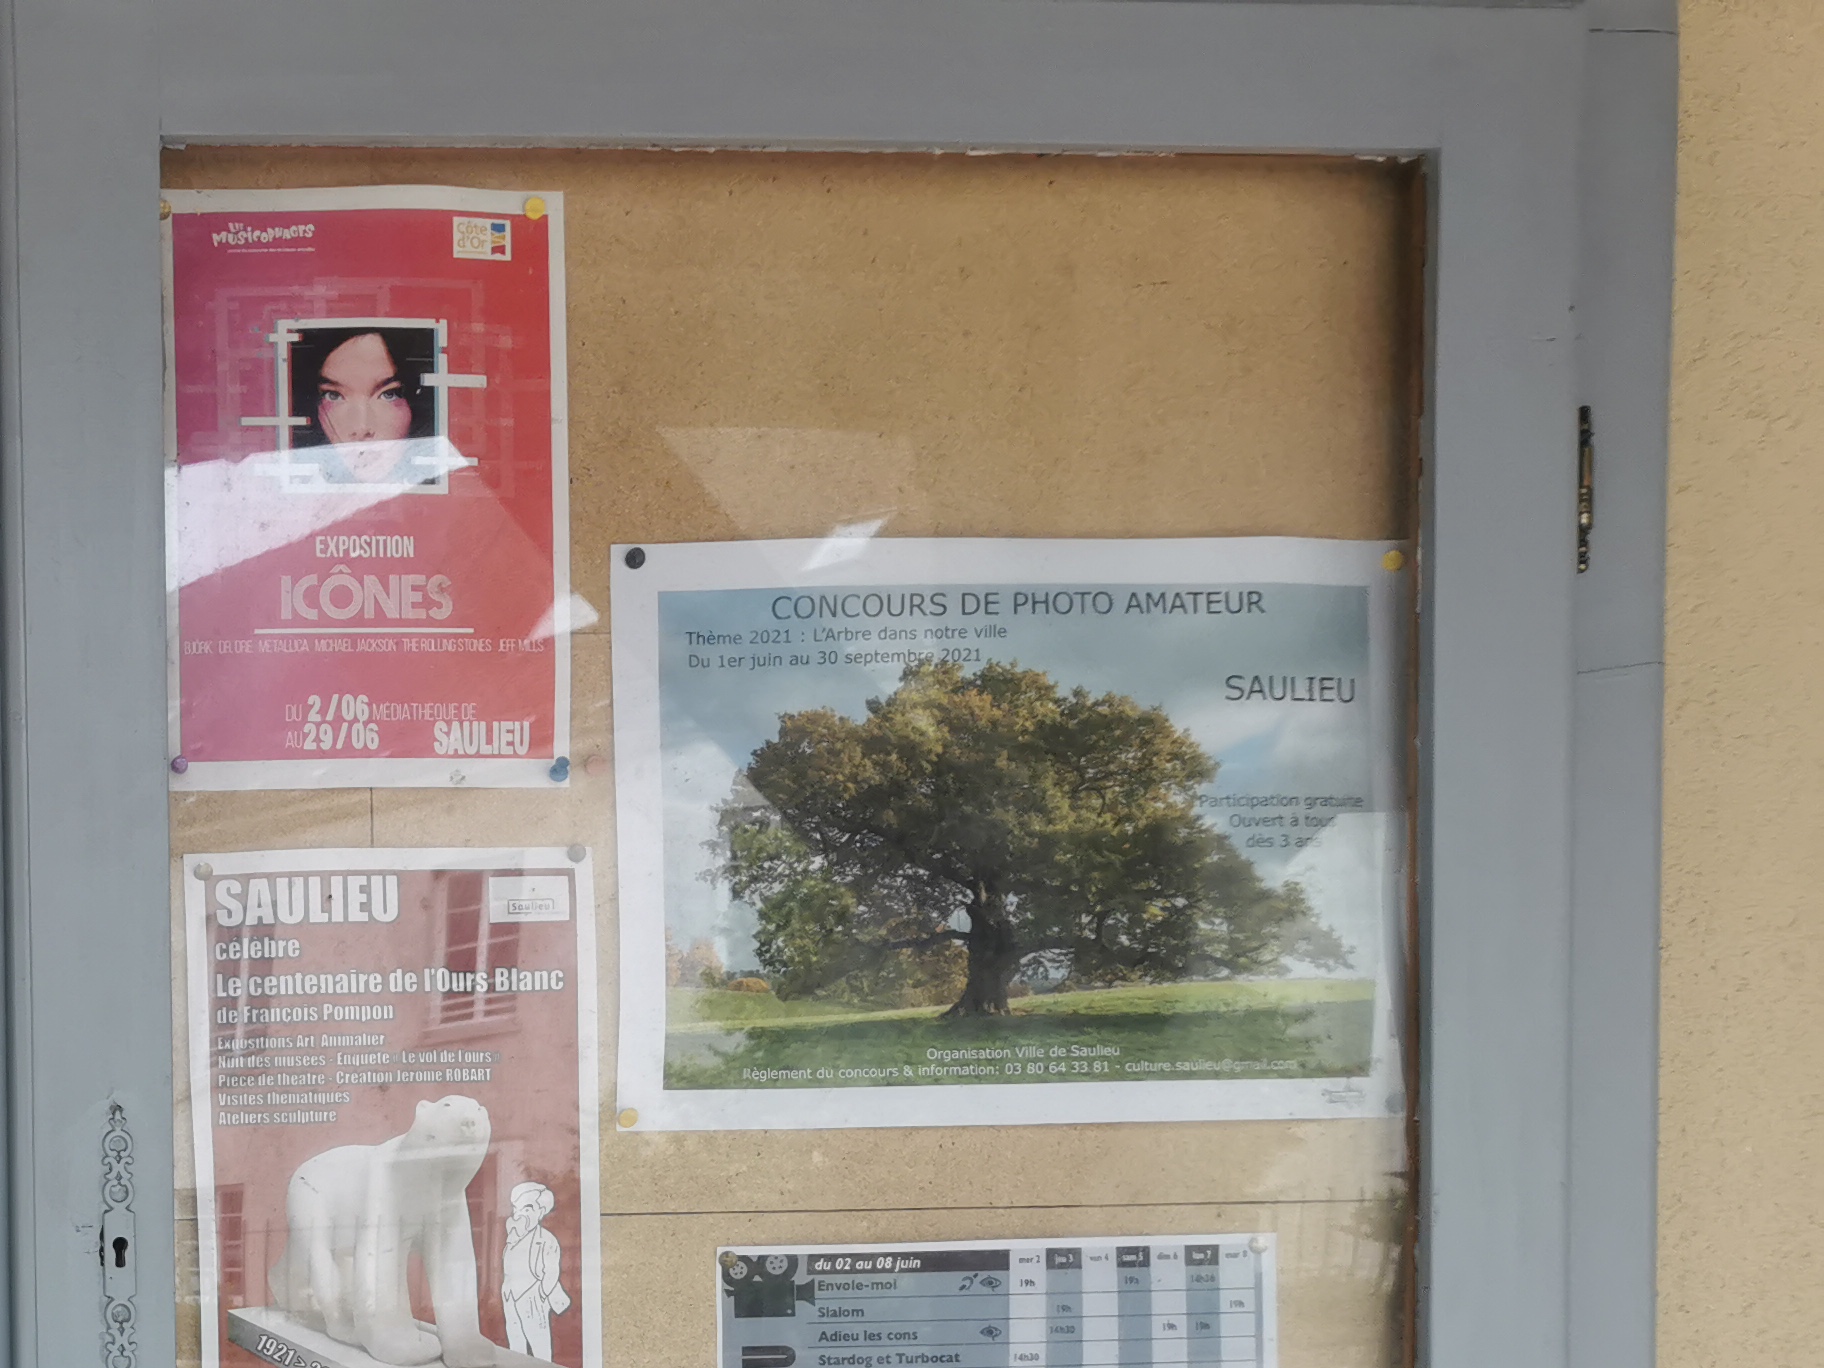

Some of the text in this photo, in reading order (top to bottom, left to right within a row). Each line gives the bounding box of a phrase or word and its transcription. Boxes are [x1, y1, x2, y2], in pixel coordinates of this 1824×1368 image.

[457, 220, 487, 236] Côte
[457, 235, 487, 249] d'Or
[315, 535, 415, 558] EXPOSITION
[280, 564, 453, 621] ICÔNES
[771, 590, 1266, 623] CONCOURS DE PHOTO AMATEUR
[686, 624, 1008, 645] Thème 2021 L'Arbre dans notre ville
[1224, 673, 1357, 704] SAULIEU
[286, 705, 302, 721] DU
[286, 731, 303, 748] AU
[433, 721, 530, 755] SAULIEU
[215, 875, 400, 927] SAULIEU
[511, 902, 552, 912] Saulieu
[216, 937, 300, 960] célèbre
[216, 967, 565, 998] Le centenaire de l'Ours Blanc
[217, 1004, 394, 1025] de François Pompon
[926, 1045, 1120, 1062] Organisation Ville de Saulieu
[446, 1069, 491, 1082] ROBART
[274, 1110, 337, 1124] sculpture
[818, 1307, 865, 1319] Slalom
[818, 1329, 918, 1342] Adieu les cons
[818, 1351, 961, 1367] Stardog et Turbocat
